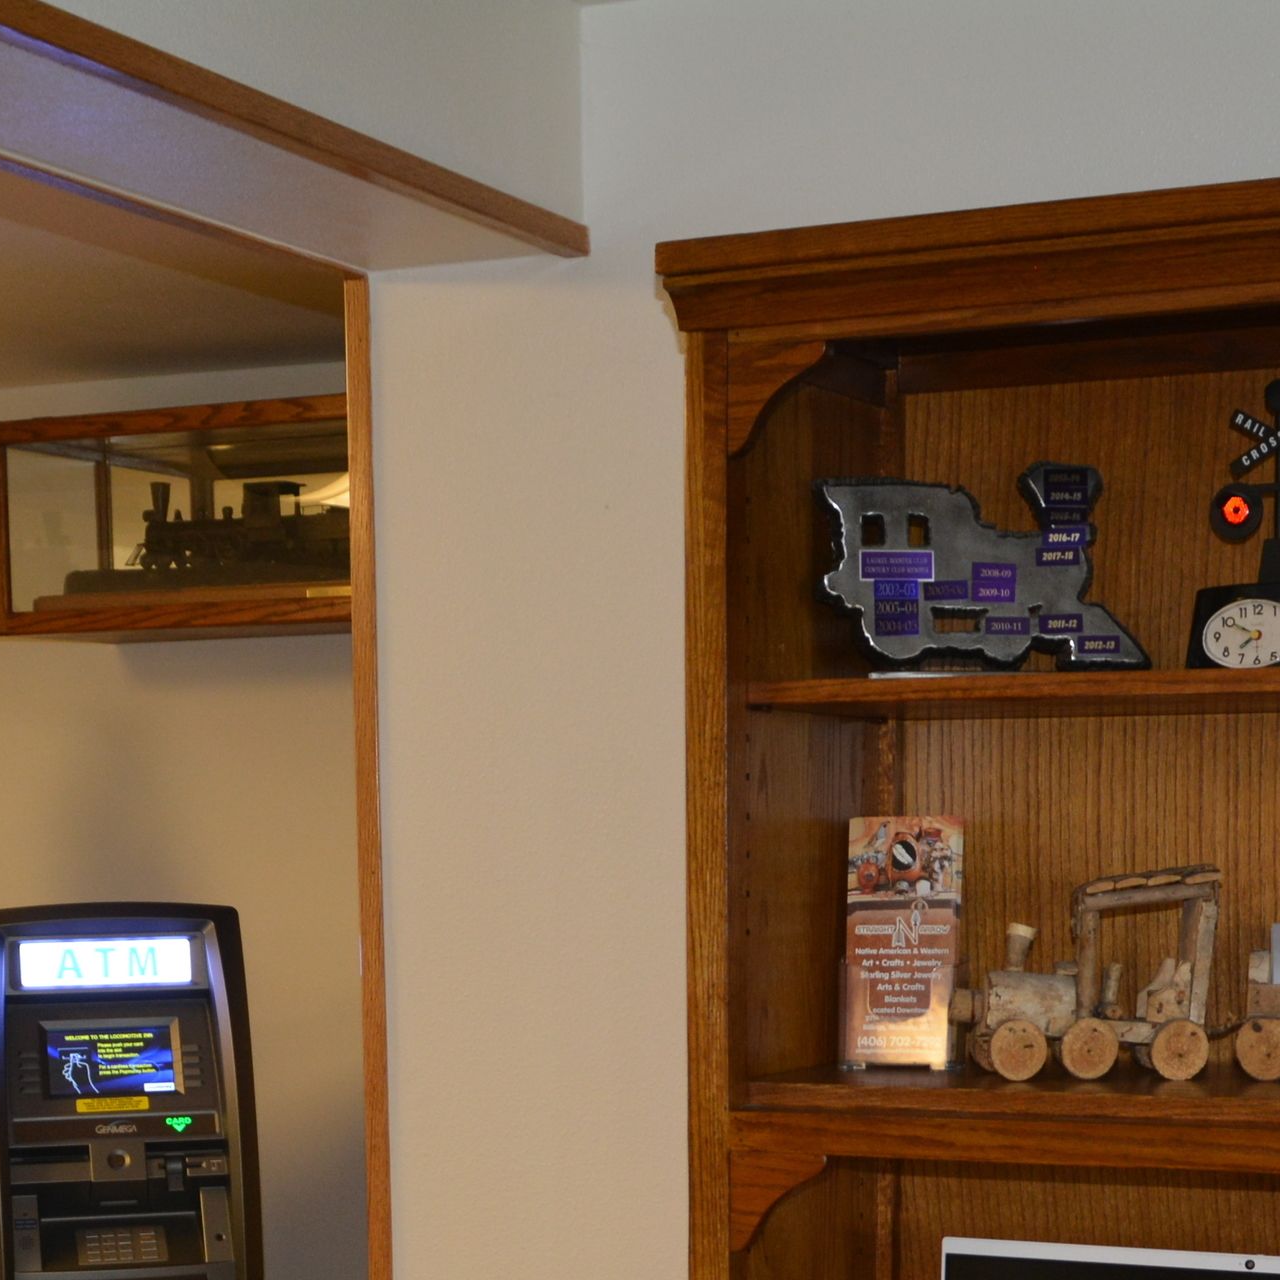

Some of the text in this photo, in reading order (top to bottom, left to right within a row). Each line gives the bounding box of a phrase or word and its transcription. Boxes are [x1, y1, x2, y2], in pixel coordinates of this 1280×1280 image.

[1235, 413, 1266, 437] RAIL
[1048, 533, 1080, 542] 2016-17
[1042, 552, 1074, 560] 2017-18
[980, 569, 1012, 578] 2008-09
[877, 583, 917, 596] 2002-03
[979, 588, 1010, 597] 2009-10
[1239, 607, 1247, 618] 11
[1252, 604, 1263, 615] 12
[1273, 605, 1277, 616] 1
[991, 622, 1022, 631] 2010-11
[1048, 619, 1078, 629] 2011-12
[1221, 617, 1235, 628] 10
[1213, 631, 1221, 642] 9
[1085, 641, 1116, 650] 2012-13
[1222, 646, 1230, 657] 8
[1270, 651, 1278, 661] 5
[1238, 653, 1245, 664] 7
[1253, 656, 1261, 665] 6
[56, 947, 159, 979] ATM
[881, 959, 904, 967] Crafts
[912, 959, 942, 968] Jewelry
[891, 971, 911, 979] Silver
[877, 983, 925, 991] Arts & Crafts
[884, 995, 917, 1003] Blankets
[872, 1006, 895, 1014] ocated
[857, 1036, 886, 1048] (406)
[166, 1117, 192, 1125] CARD
